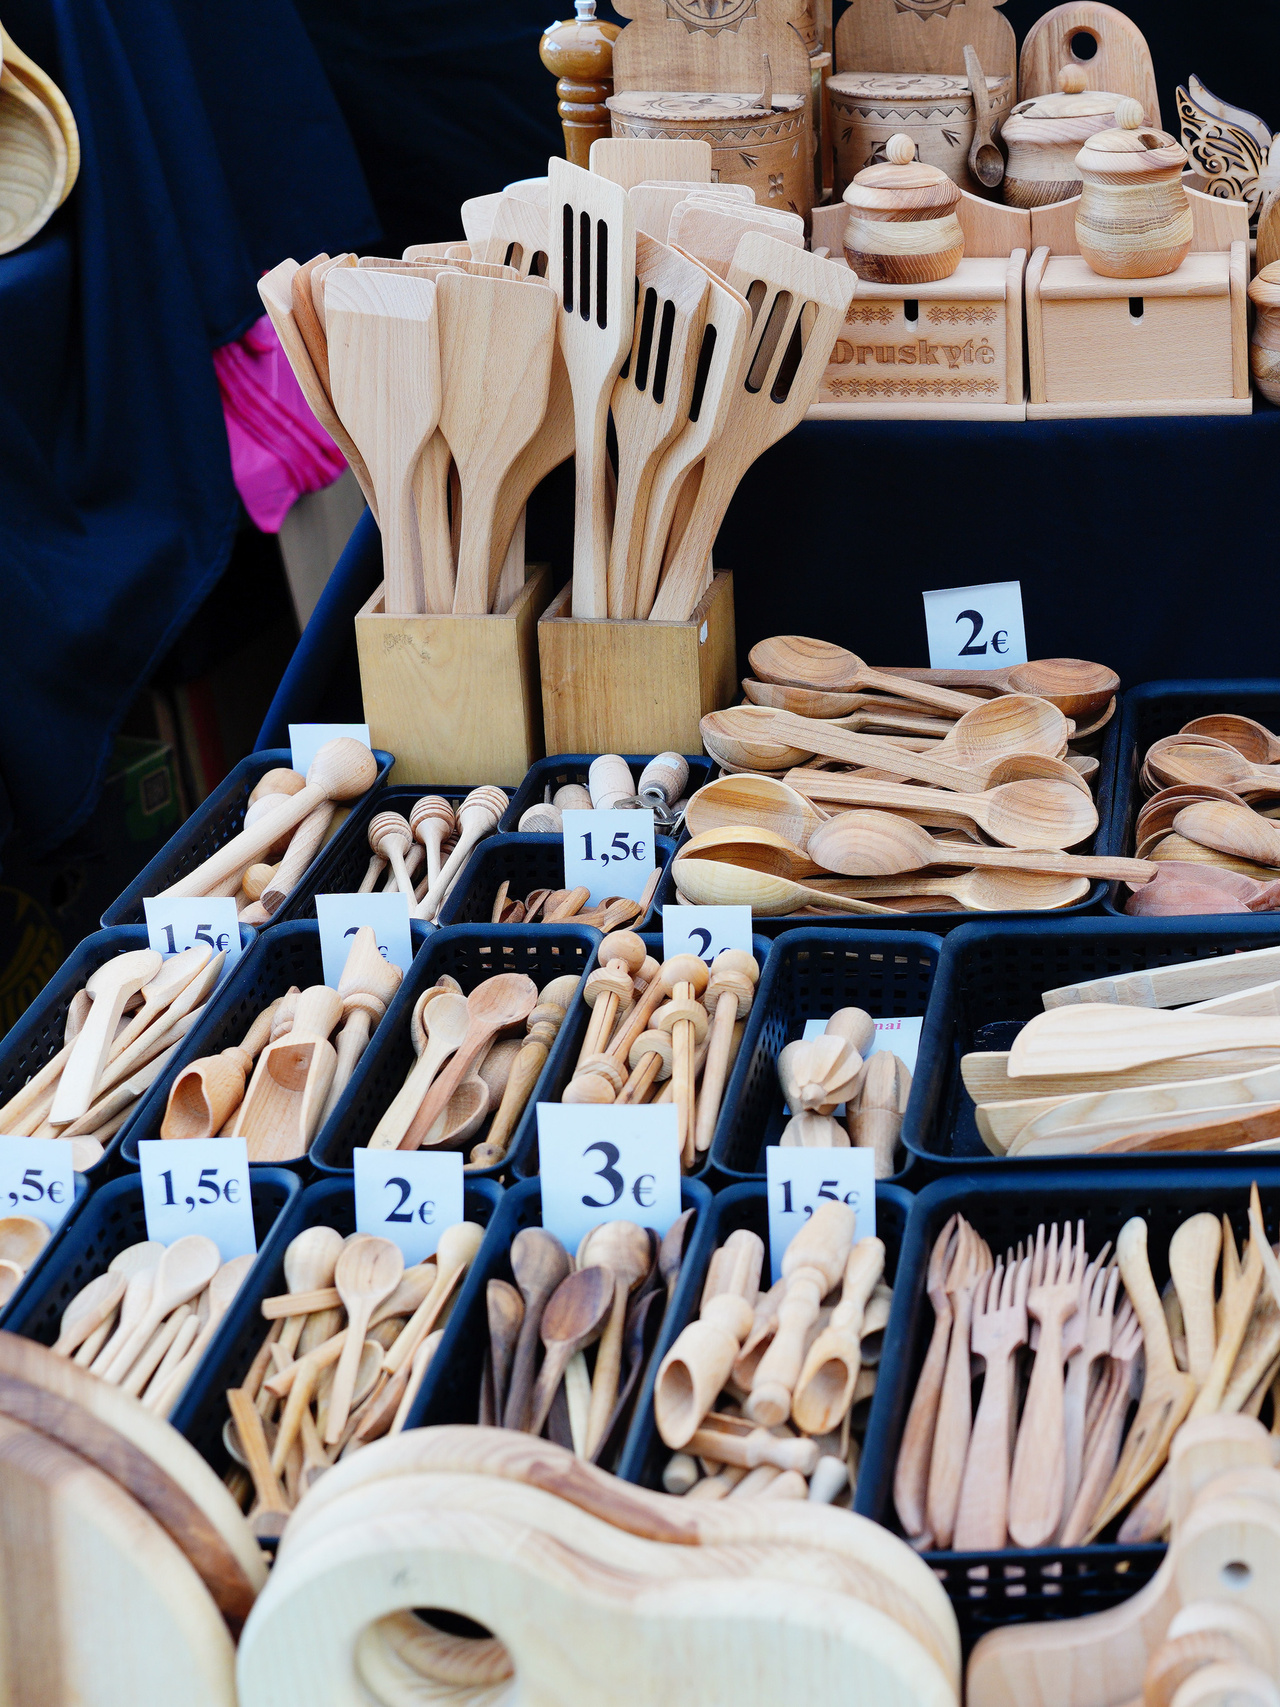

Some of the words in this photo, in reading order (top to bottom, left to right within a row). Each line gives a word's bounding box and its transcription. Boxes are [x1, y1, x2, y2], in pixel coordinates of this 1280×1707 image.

[829, 338, 995, 369] Druskytė
[954, 609, 1010, 656] 2€
[580, 831, 646, 867] 1,5€
[687, 927, 732, 968] 2
[0, 1168, 65, 1208] ,5€
[158, 1168, 242, 1214] 1,5€
[581, 1141, 657, 1208] 3€
[384, 1177, 436, 1225] 2€
